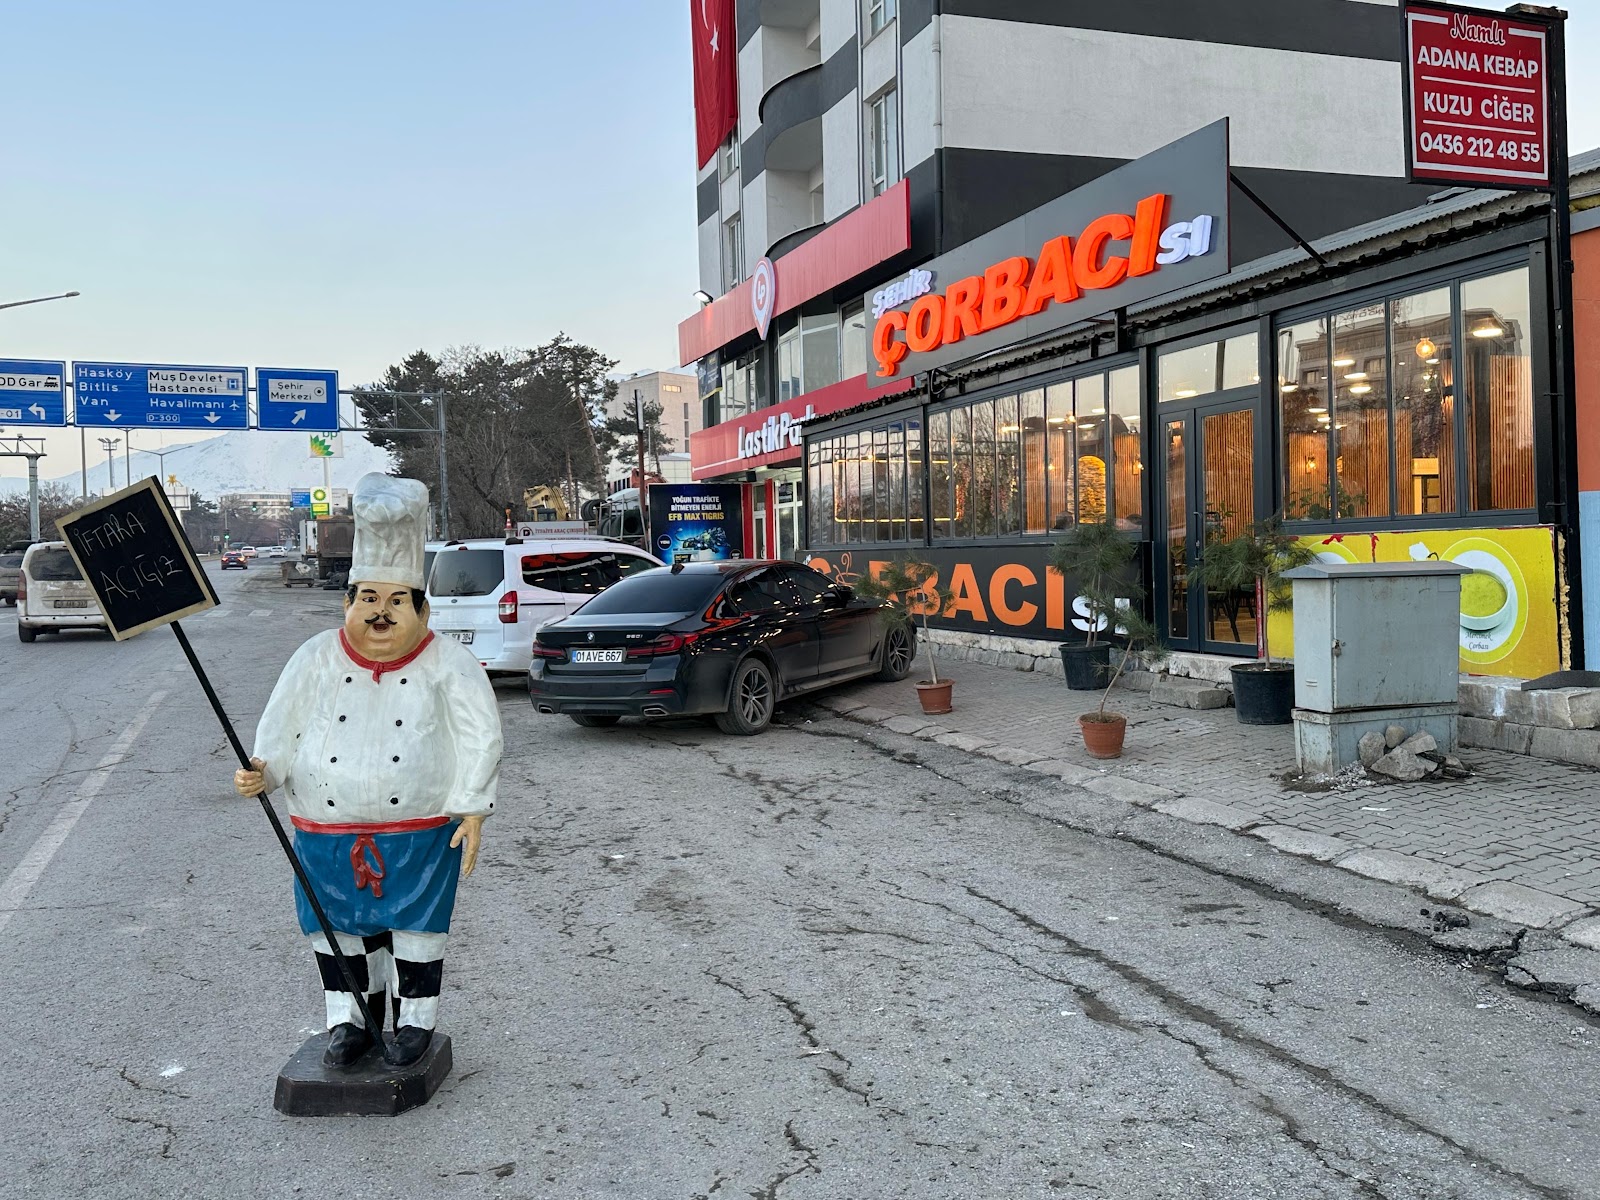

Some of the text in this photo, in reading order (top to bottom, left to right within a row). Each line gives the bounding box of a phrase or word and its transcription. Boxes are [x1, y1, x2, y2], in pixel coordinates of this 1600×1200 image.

[1450, 13, 1505, 46] Namlı
[1417, 45, 1539, 79] ADANA KEBAP
[1423, 91, 1535, 124] KUZU CİĞER
[1419, 131, 1541, 163] 0436 212 48 55
[78, 367, 133, 381] Hasköy
[149, 371, 223, 383] Muş Devlet
[18, 377, 41, 388] Gar
[79, 381, 119, 392] Bitlis
[149, 382, 218, 394] Hastanesi
[277, 381, 304, 391] Şehir
[80, 395, 109, 406] Van
[270, 391, 312, 401] Merkezi
[149, 397, 225, 409] Havalimanı
[148, 414, 178, 422] D-300
[671, 495, 720, 504] YOĞUN TRAFİKTE
[670, 503, 722, 511] BİTMEYEN ENERJİ
[668, 512, 725, 521] EFB MAX TIGRIS
[72, 511, 147, 557] İFTARA
[576, 651, 621, 661] 01 AVE 667
